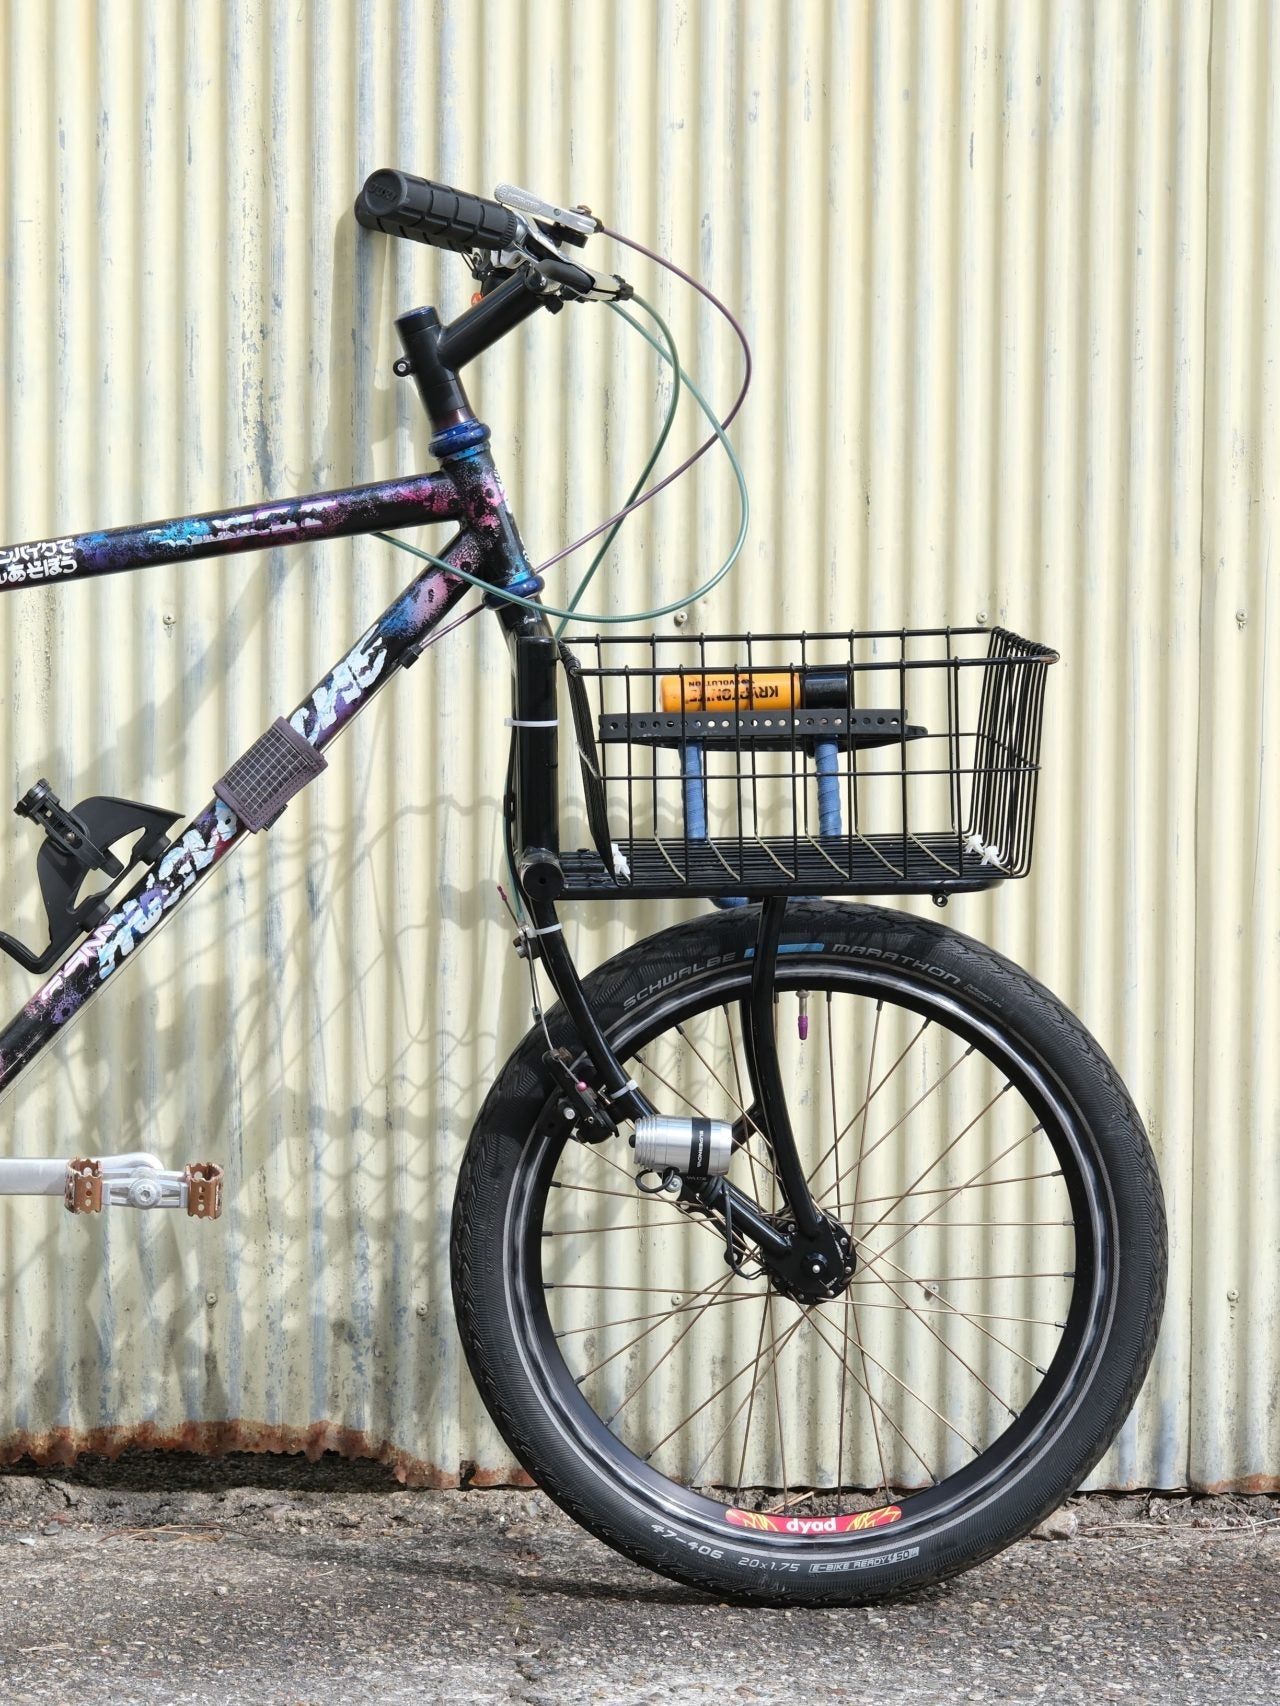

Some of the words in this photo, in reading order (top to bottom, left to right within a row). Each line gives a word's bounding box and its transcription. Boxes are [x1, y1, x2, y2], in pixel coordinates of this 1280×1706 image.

[622, 952, 737, 1010] SCHWALBE
[832, 943, 961, 985] MARATHON
[650, 1523, 724, 1559] 47-406
[737, 1556, 800, 1572] 20x1.75
[812, 1562, 849, 1572] E-BIKE
[853, 1556, 888, 1568] READY
[785, 1517, 837, 1534] dyad
